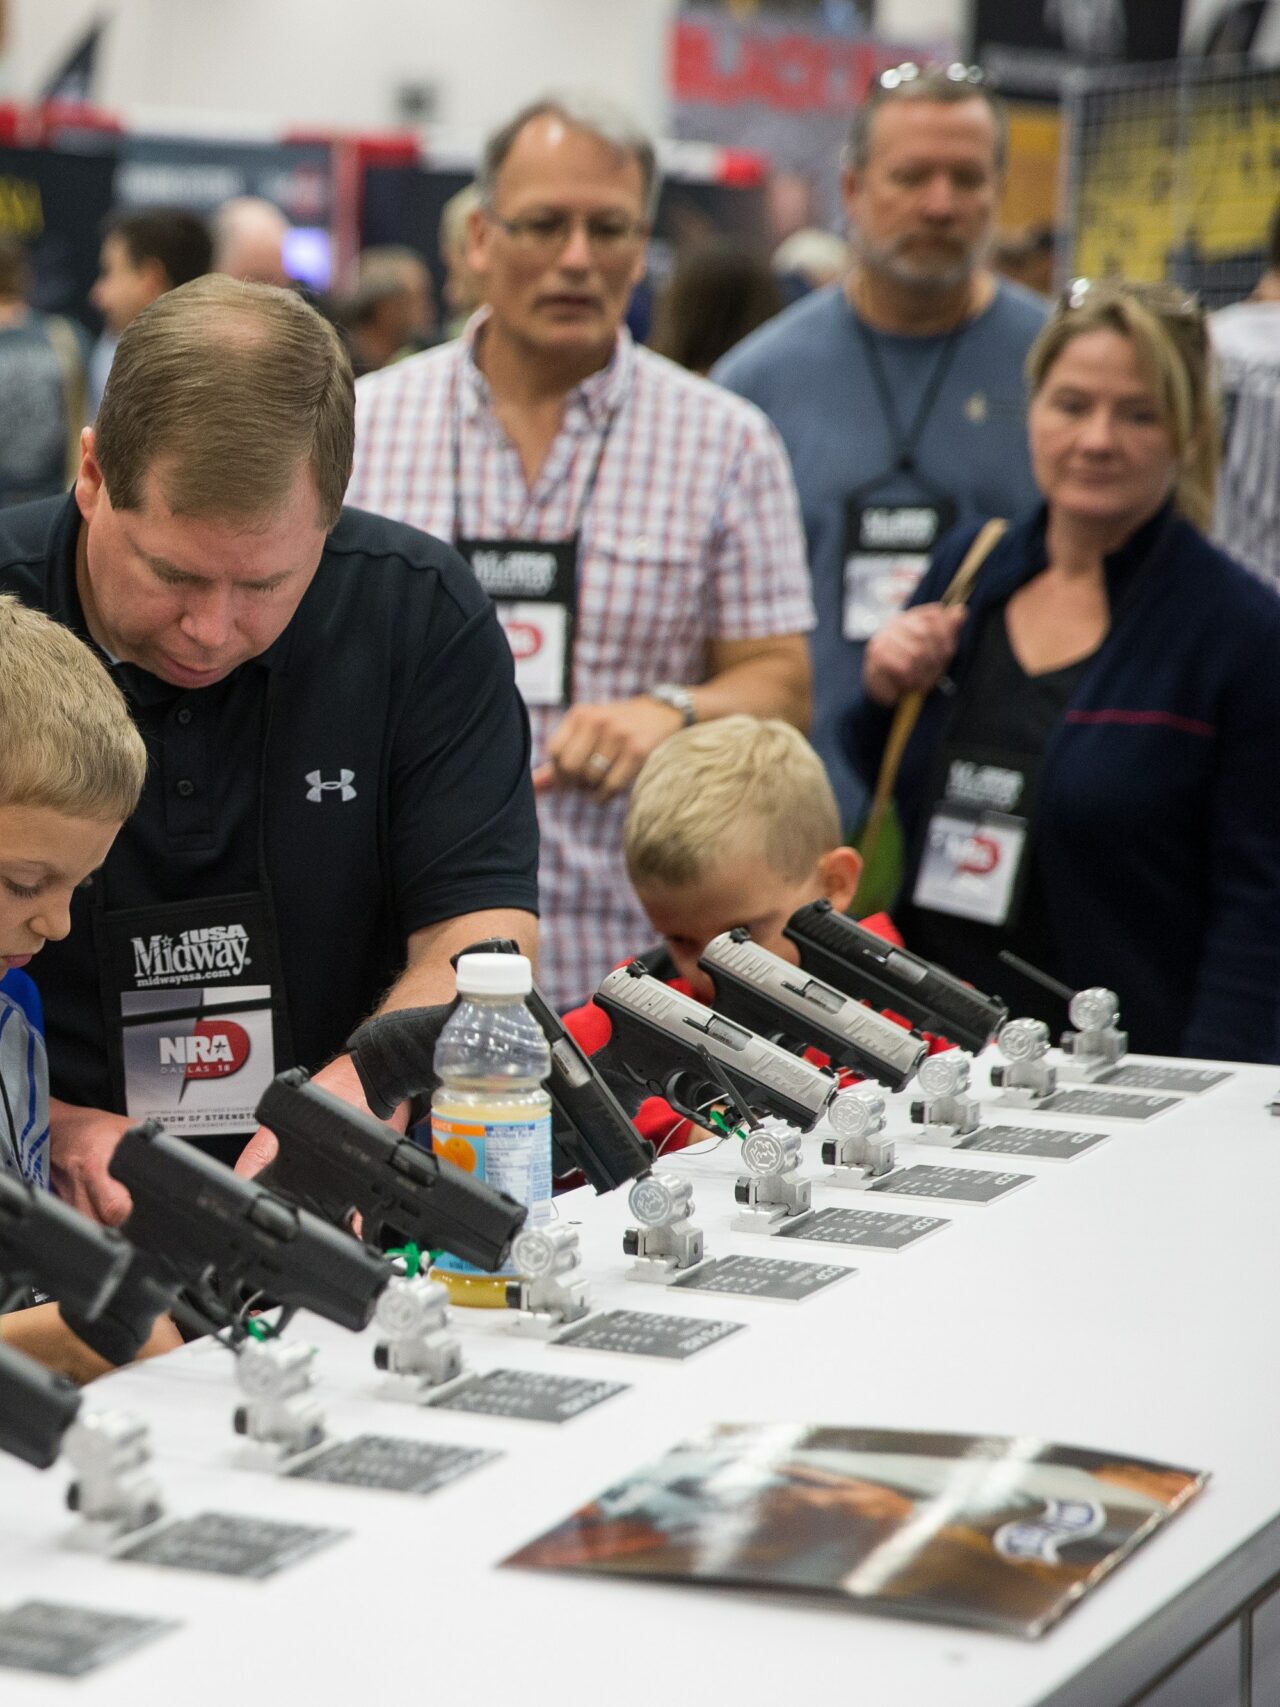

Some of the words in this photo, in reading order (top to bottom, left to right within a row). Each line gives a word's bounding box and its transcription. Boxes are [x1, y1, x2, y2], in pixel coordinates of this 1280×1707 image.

[191, 924, 248, 943] USA
[131, 933, 249, 977] Midway
[136, 969, 231, 988] midwayusa.com
[159, 1034, 235, 1064] NRA
[160, 1065, 210, 1074] DALLAS
[994, 1173, 1020, 1185] CCP
[912, 1217, 939, 1231] CCP
[816, 1265, 845, 1280] CCP
